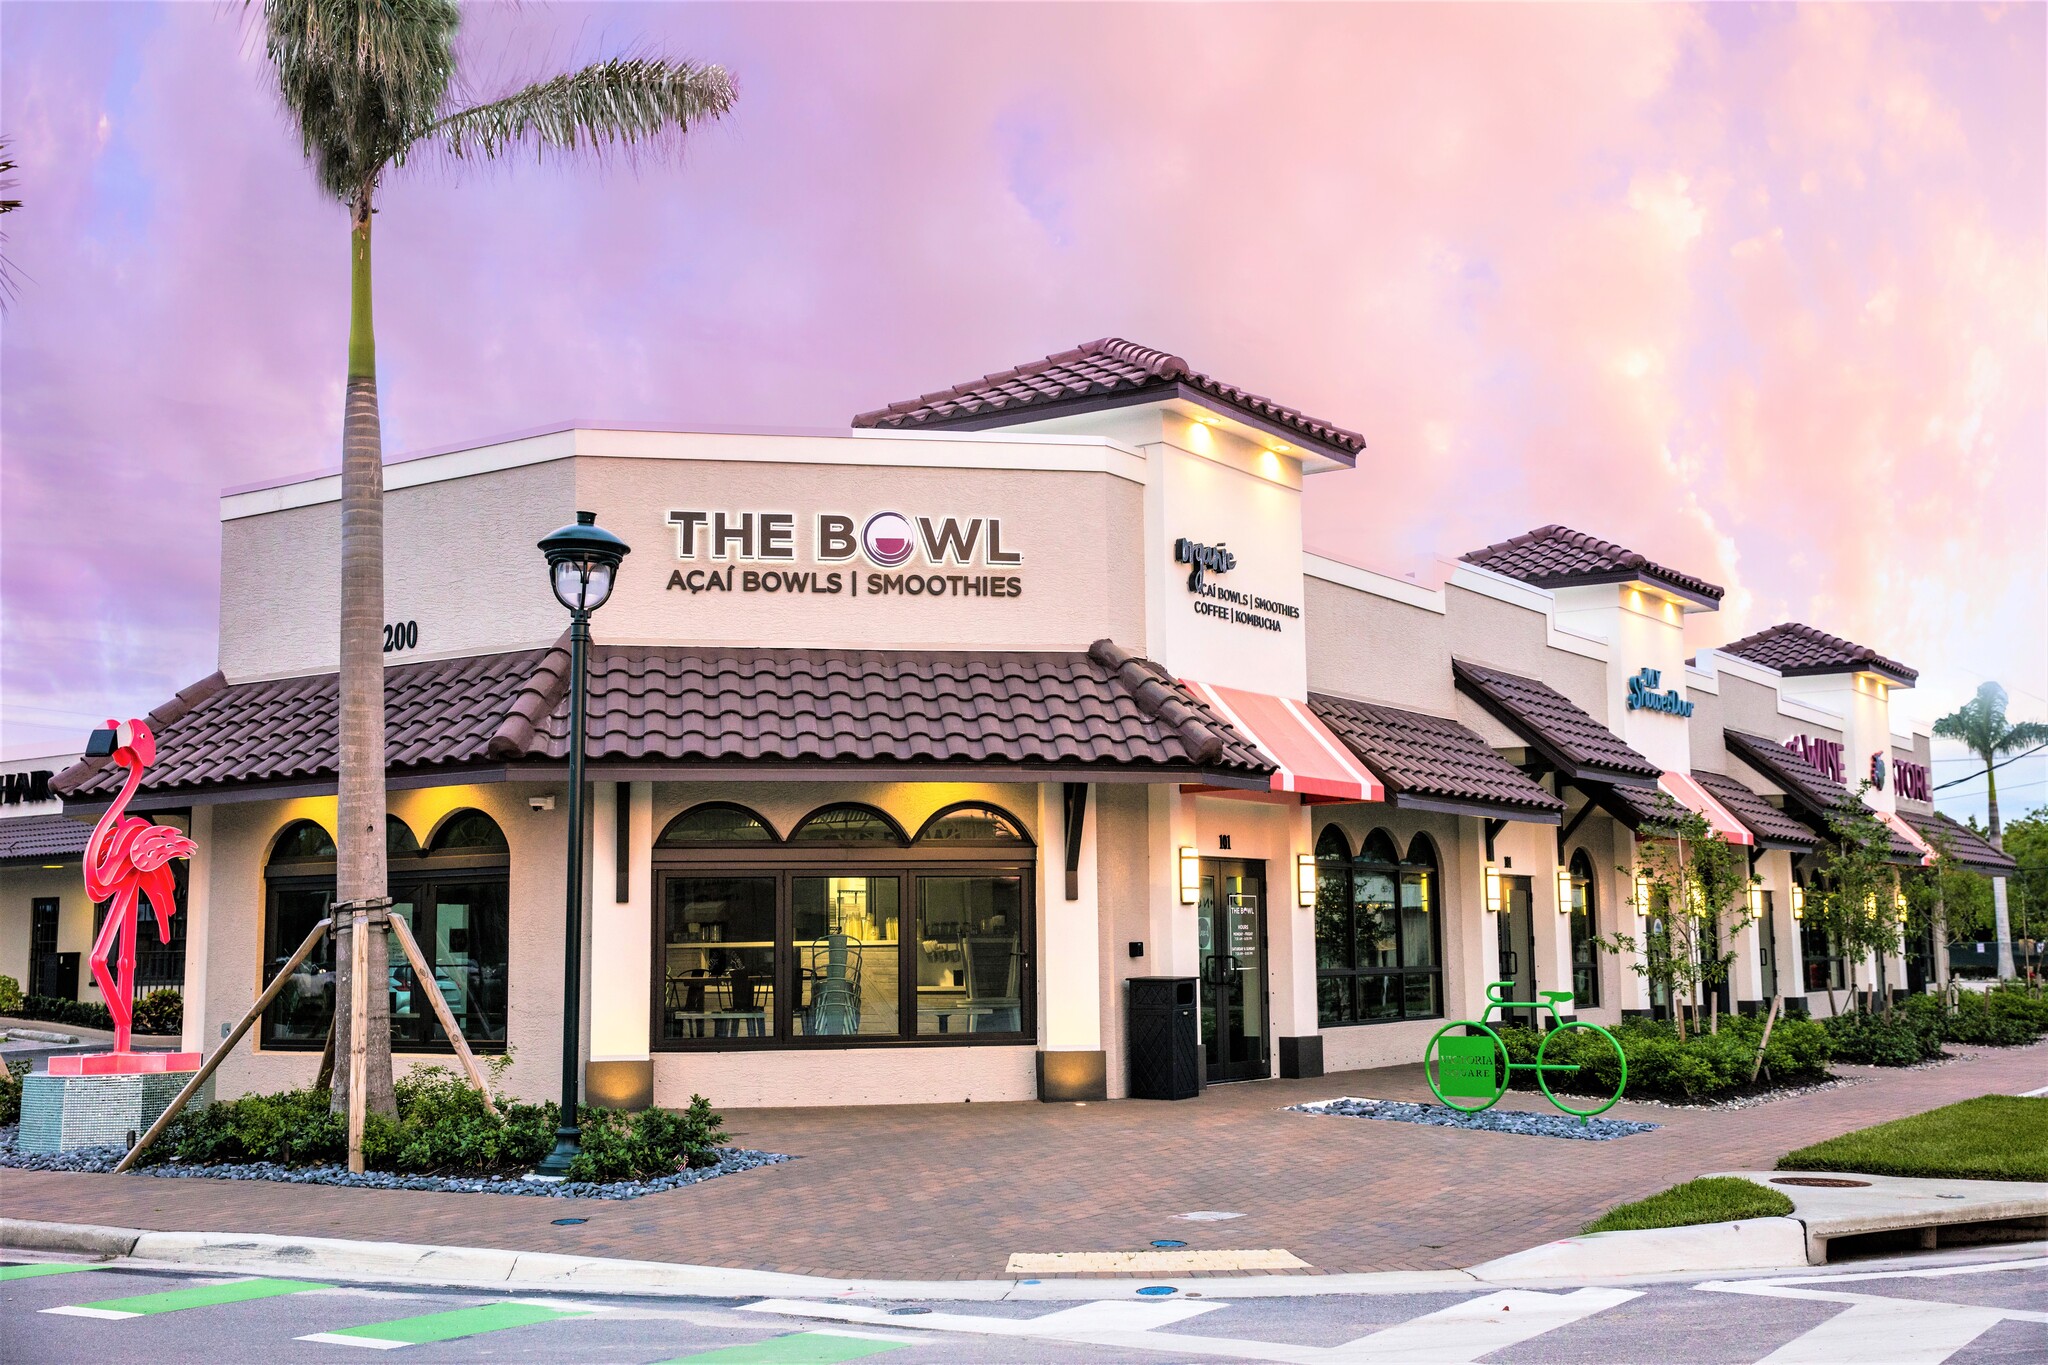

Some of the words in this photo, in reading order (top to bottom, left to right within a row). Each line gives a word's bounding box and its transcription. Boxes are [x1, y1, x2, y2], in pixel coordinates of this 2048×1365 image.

[668, 510, 795, 561] THE
[816, 509, 1024, 568] BOWL
[666, 564, 735, 595] AÇAÍ
[742, 569, 842, 594] BOWLS
[867, 573, 1023, 598] SMOOTHIES
[1199, 582, 1216, 598] ÇAÍ
[1217, 587, 1249, 606] BOWLS
[1254, 597, 1299, 618] SMOOTHIES
[1194, 601, 1229, 620] COFFEE
[1235, 610, 1281, 632] KOMBUCHA
[1218, 834, 1231, 850] 101
[1440, 1055, 1493, 1066] VICTORIA
